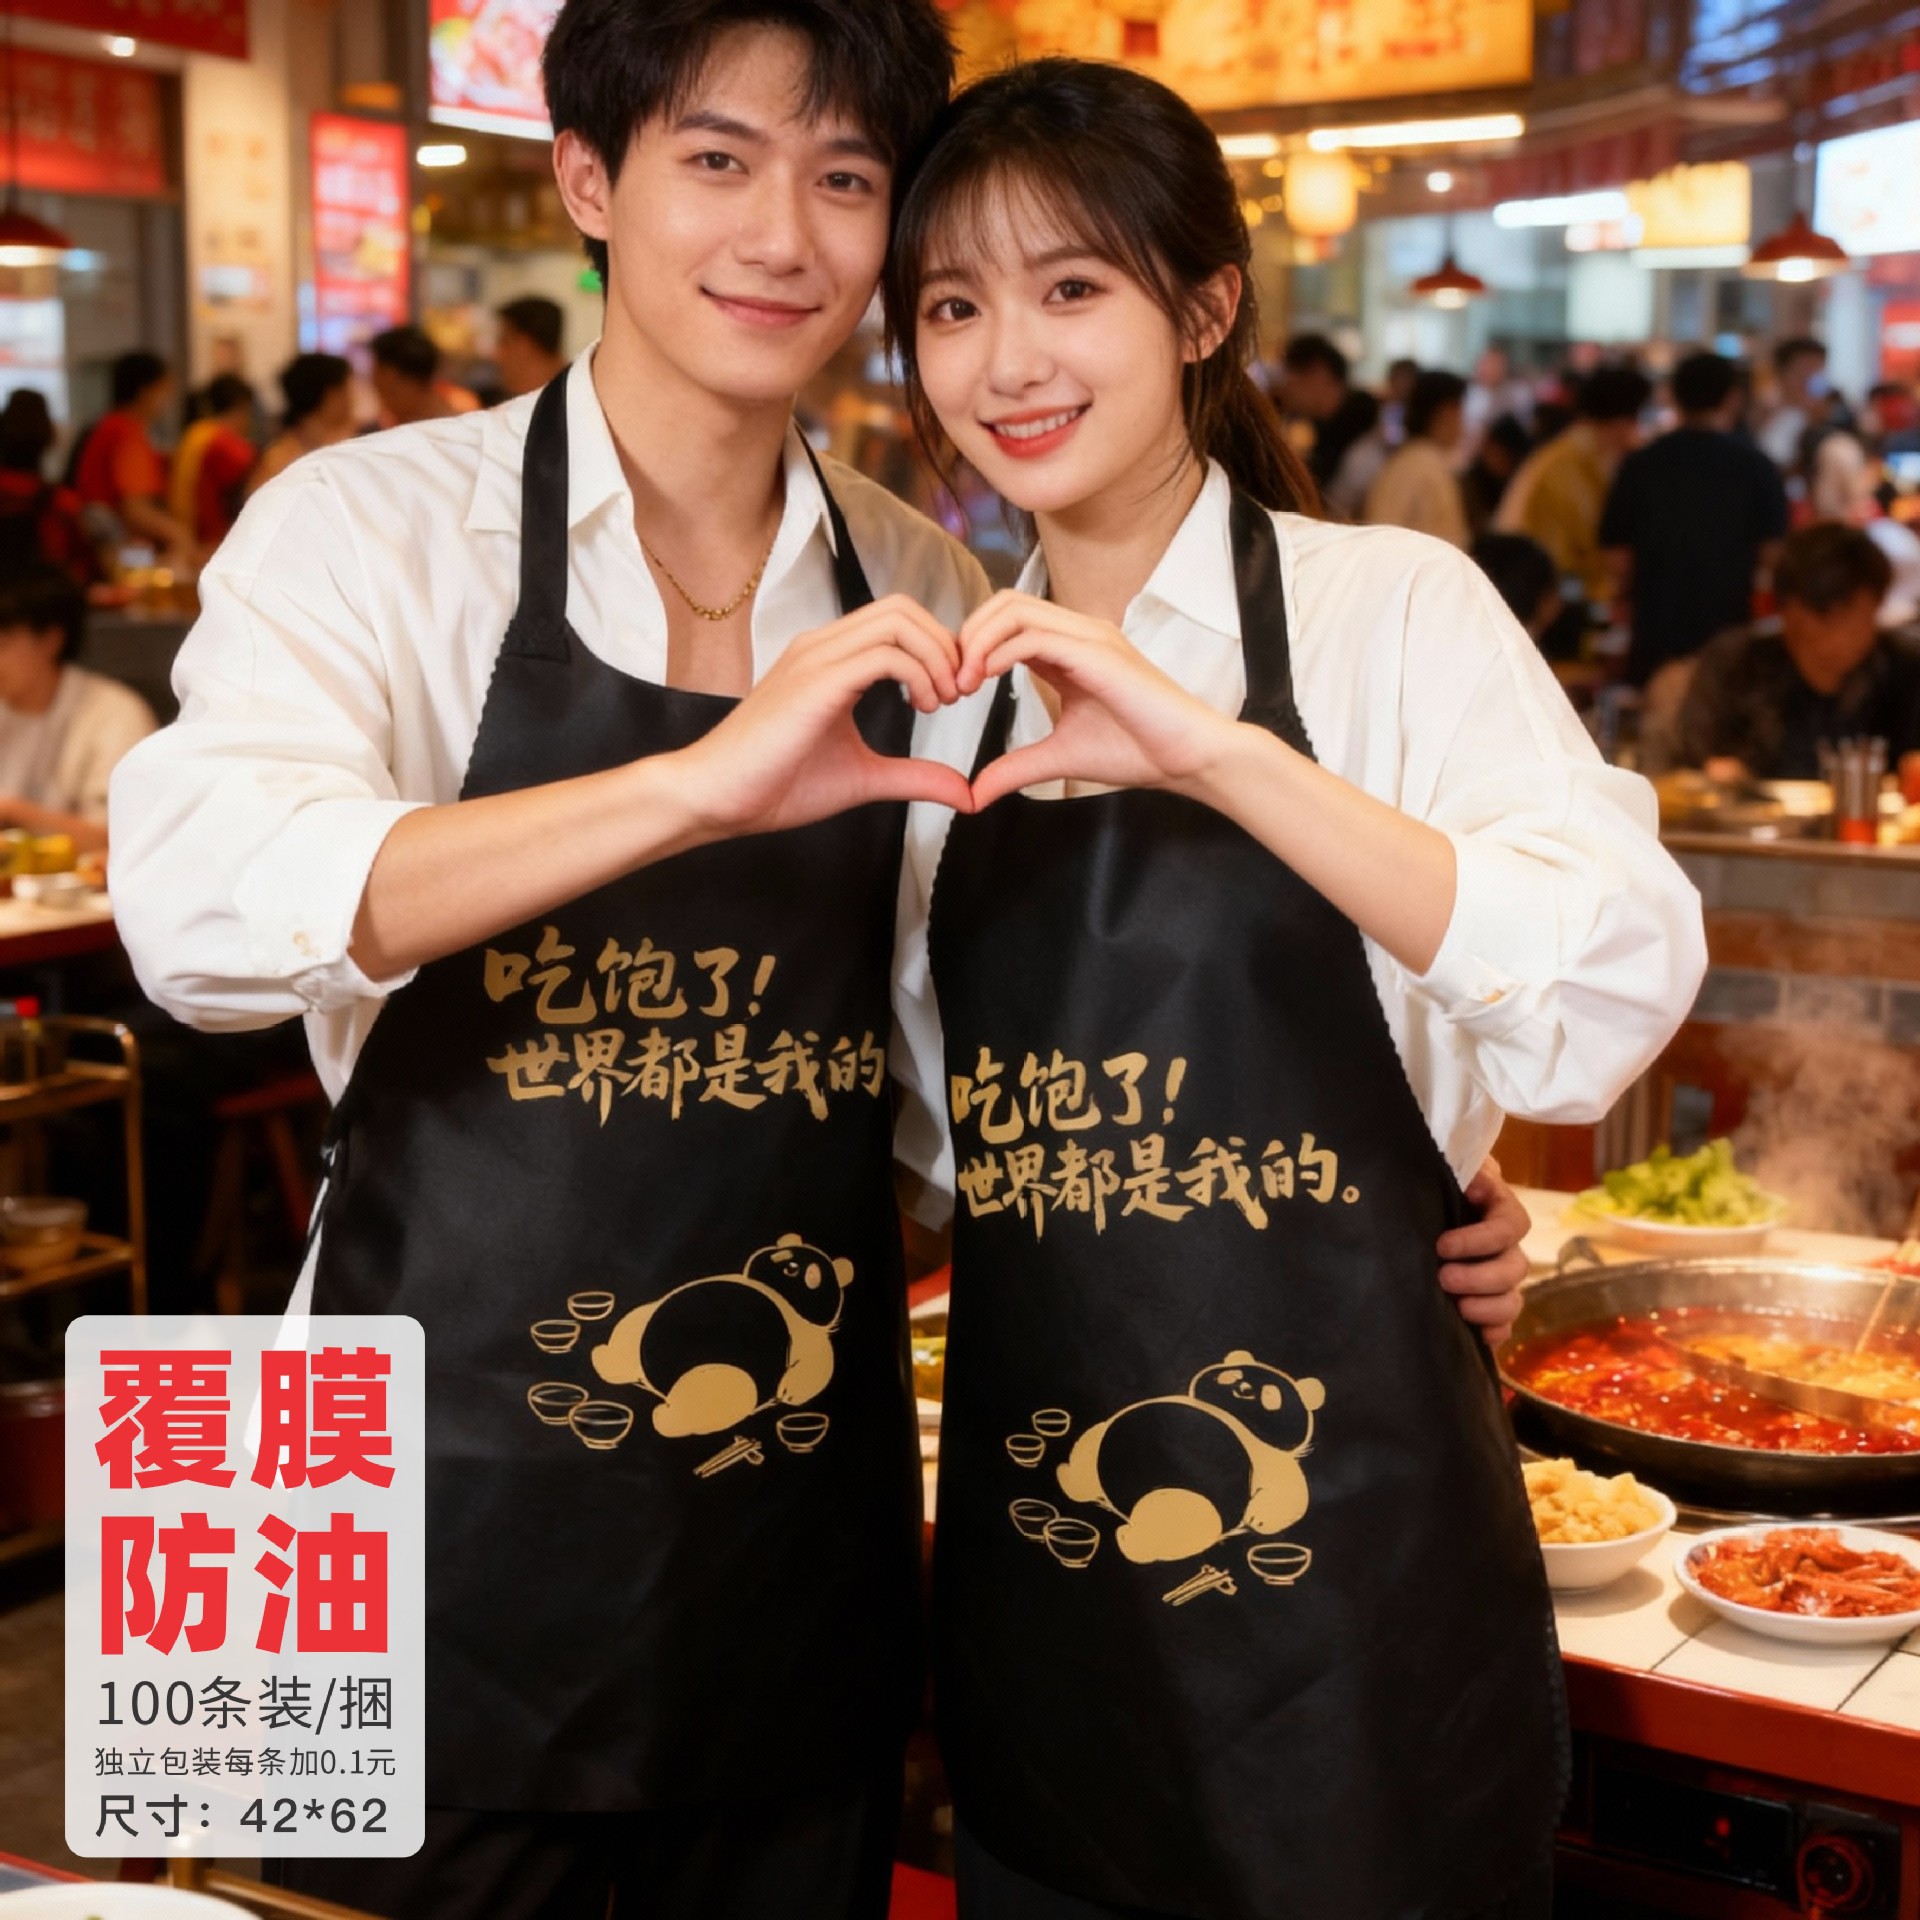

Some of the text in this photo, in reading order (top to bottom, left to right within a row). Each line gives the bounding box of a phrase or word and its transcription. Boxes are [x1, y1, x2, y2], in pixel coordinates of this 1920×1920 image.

[485, 1024, 885, 1127] 世界都是我的
[957, 1132, 1360, 1243] 世界都是我的。
